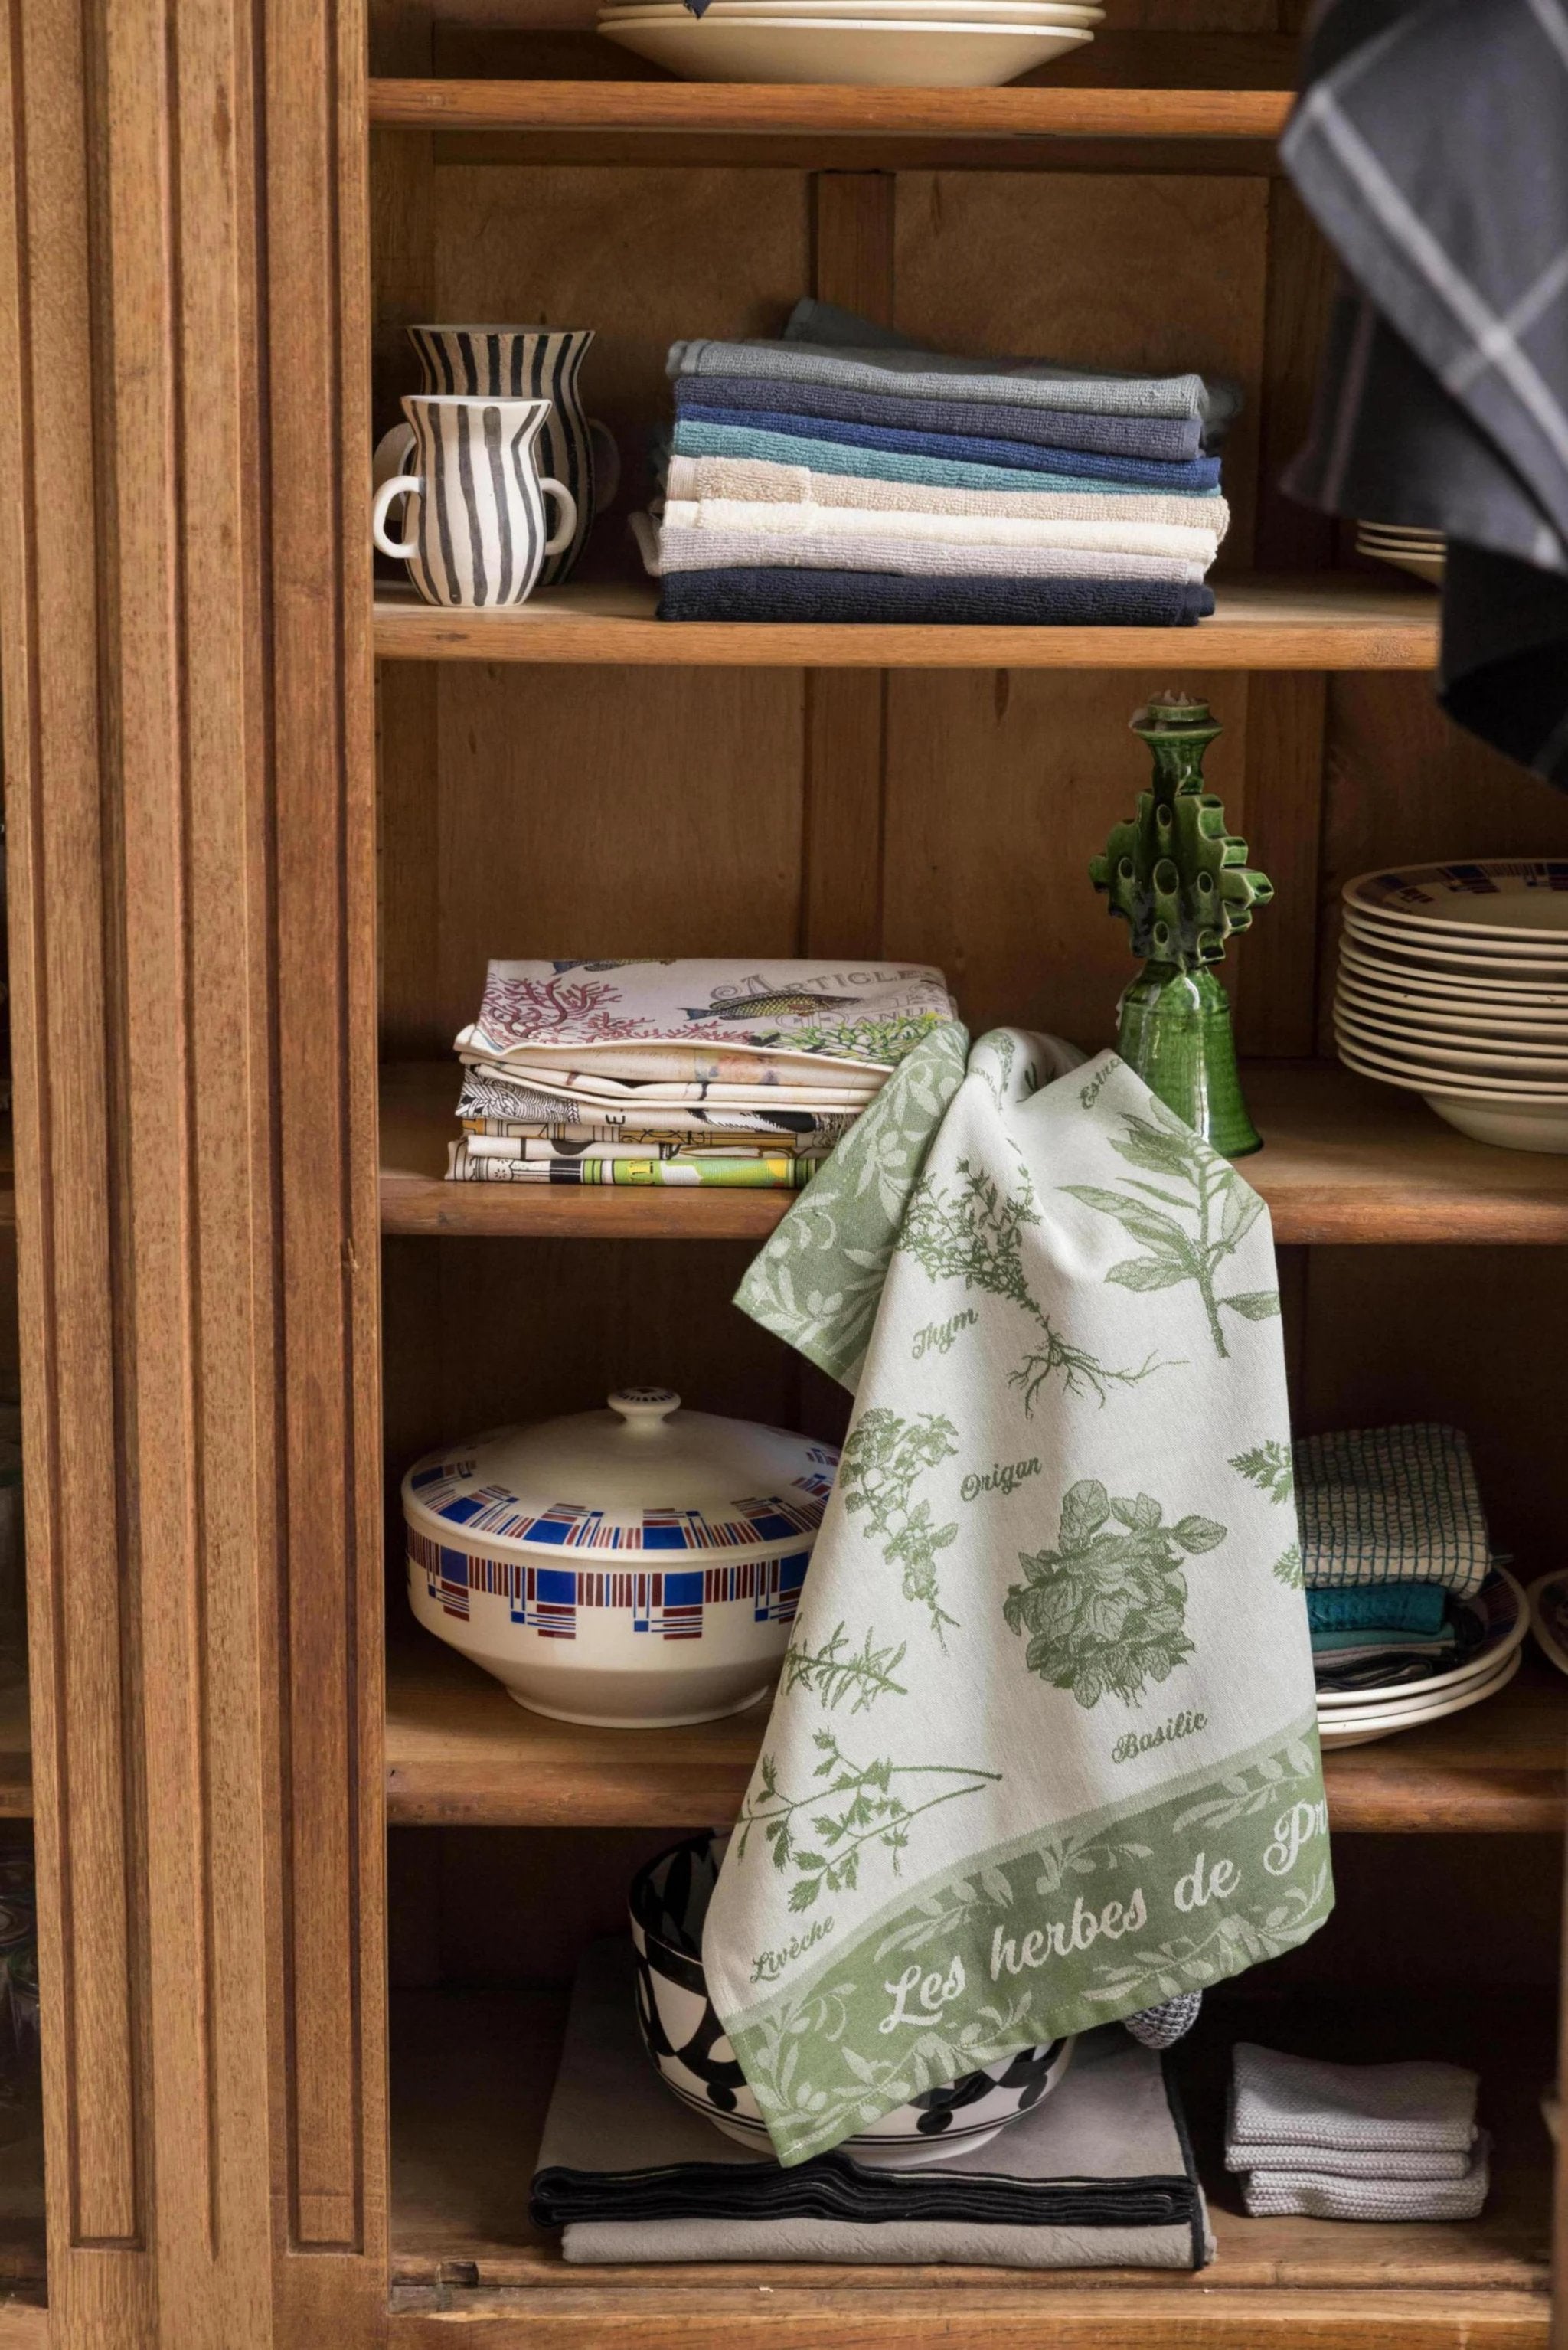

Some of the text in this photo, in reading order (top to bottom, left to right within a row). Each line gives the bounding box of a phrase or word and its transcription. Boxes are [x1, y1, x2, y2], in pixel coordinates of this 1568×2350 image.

[913, 1307, 978, 1360] Thym
[961, 1457, 1042, 1502] Origan
[1111, 1710, 1209, 1764] Basilic
[749, 1915, 835, 1985] Livèche
[878, 1953, 965, 2035] Les
[990, 1887, 1148, 1982] herbes
[1173, 1852, 1242, 1914] de
